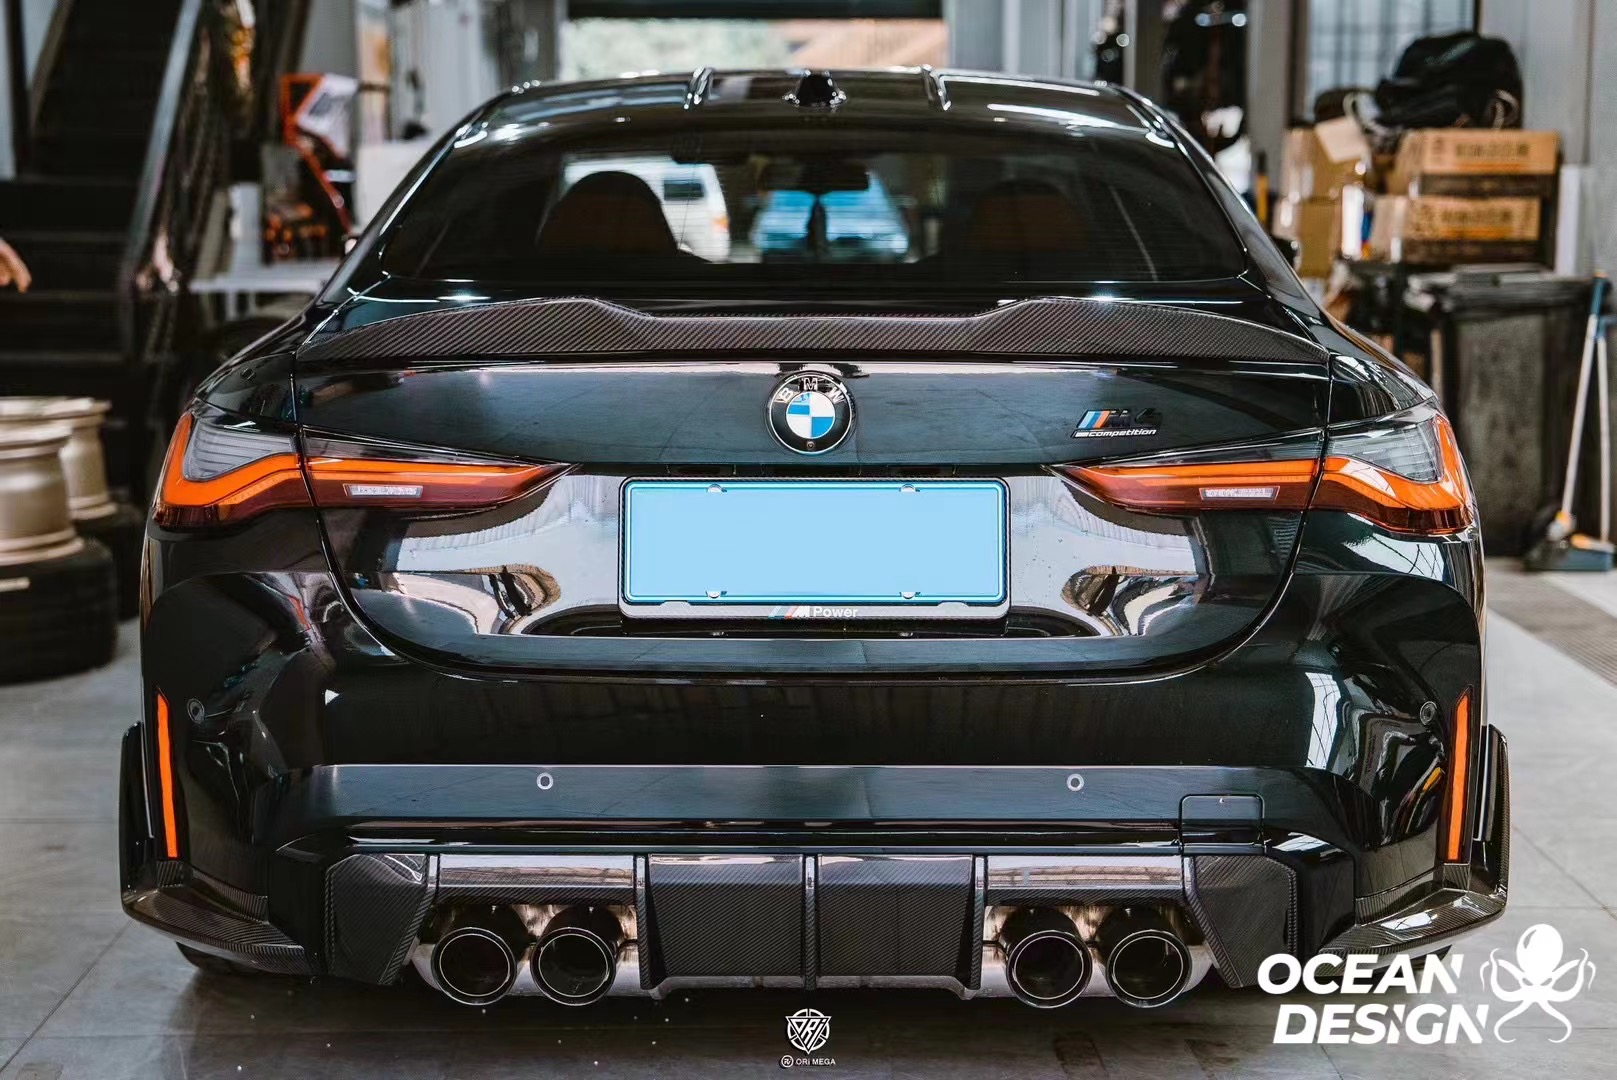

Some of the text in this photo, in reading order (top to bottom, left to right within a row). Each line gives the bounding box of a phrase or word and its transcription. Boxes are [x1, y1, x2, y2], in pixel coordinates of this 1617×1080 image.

[775, 377, 846, 404] BMW
[1088, 428, 1157, 438] competition
[813, 605, 858, 618] Power
